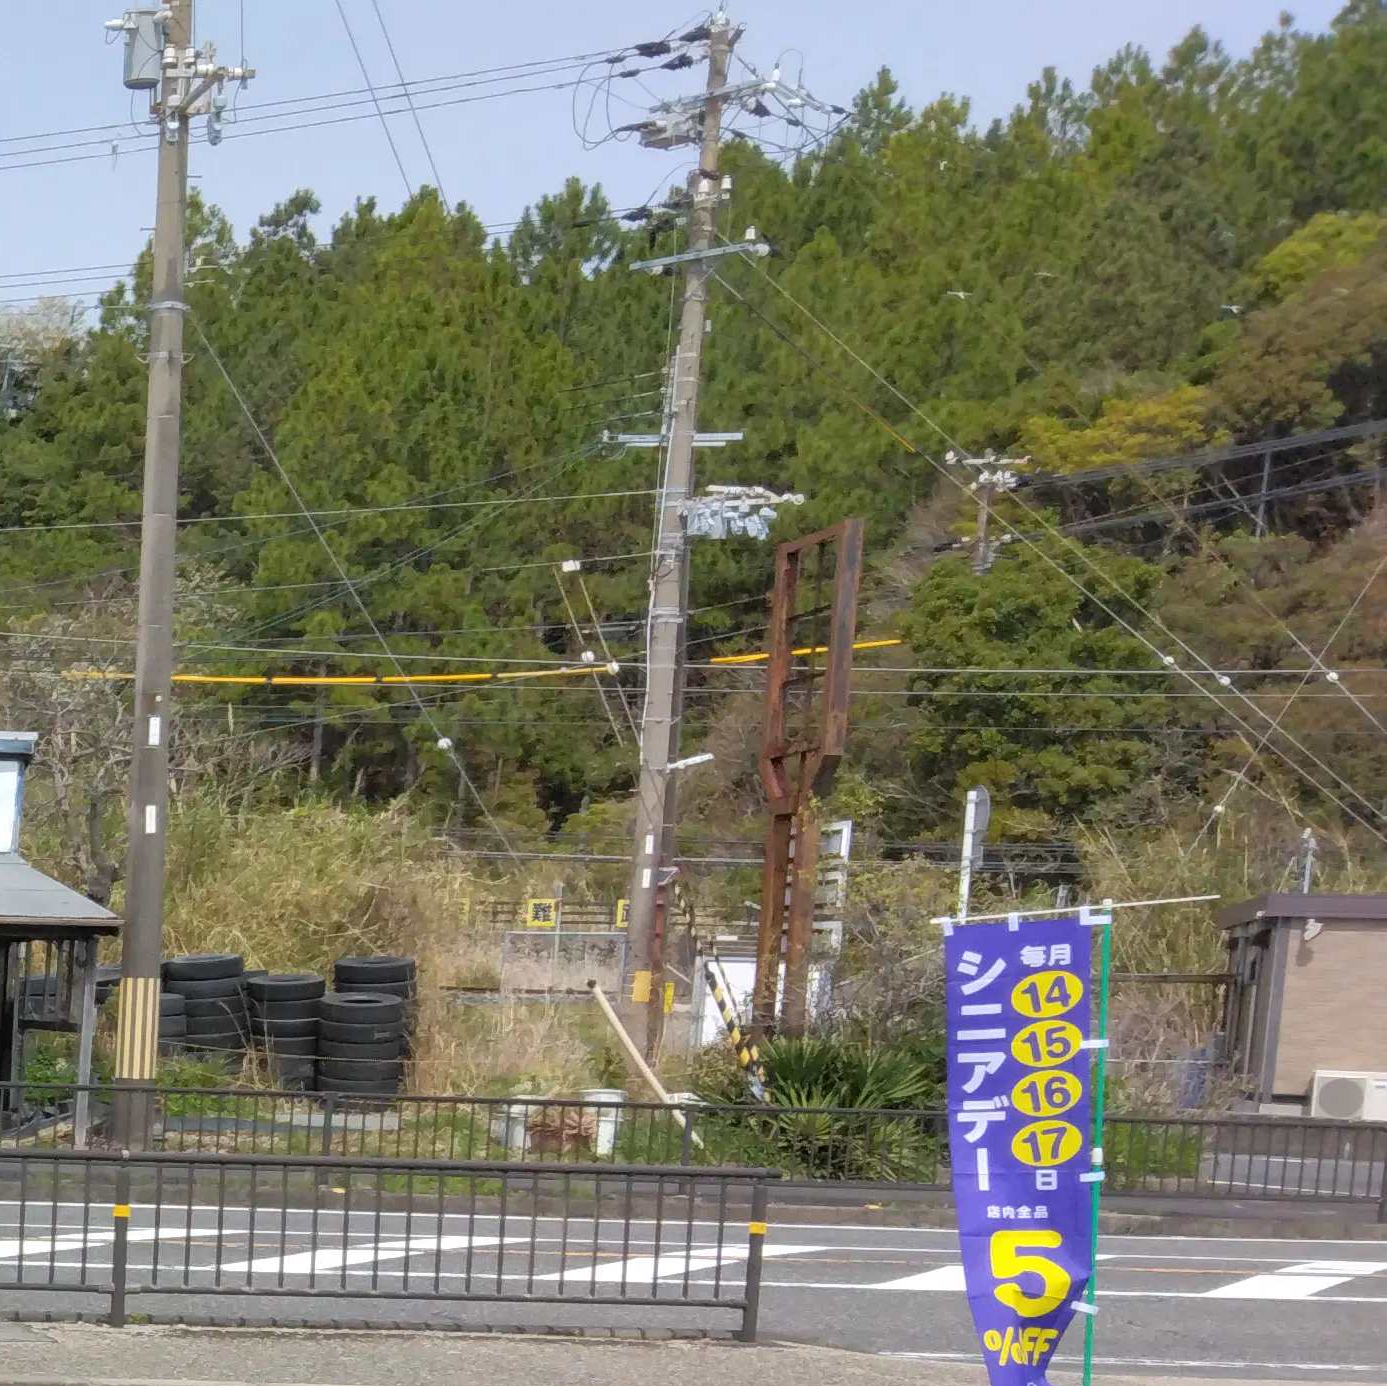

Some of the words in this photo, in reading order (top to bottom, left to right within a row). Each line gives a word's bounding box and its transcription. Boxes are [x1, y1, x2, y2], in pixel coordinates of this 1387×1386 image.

[1020, 944, 1072, 967] 毎月
[1021, 975, 1072, 1013] 14
[1021, 1025, 1072, 1063] 15
[957, 950, 1010, 1191] シニアデー
[1021, 1076, 1072, 1112] 16
[1021, 1126, 1068, 1163] 17
[1036, 1169, 1058, 1191] 日
[987, 1205, 1049, 1219] 店内全品
[990, 1229, 1072, 1318] 5
[983, 1326, 1059, 1367] %FF
